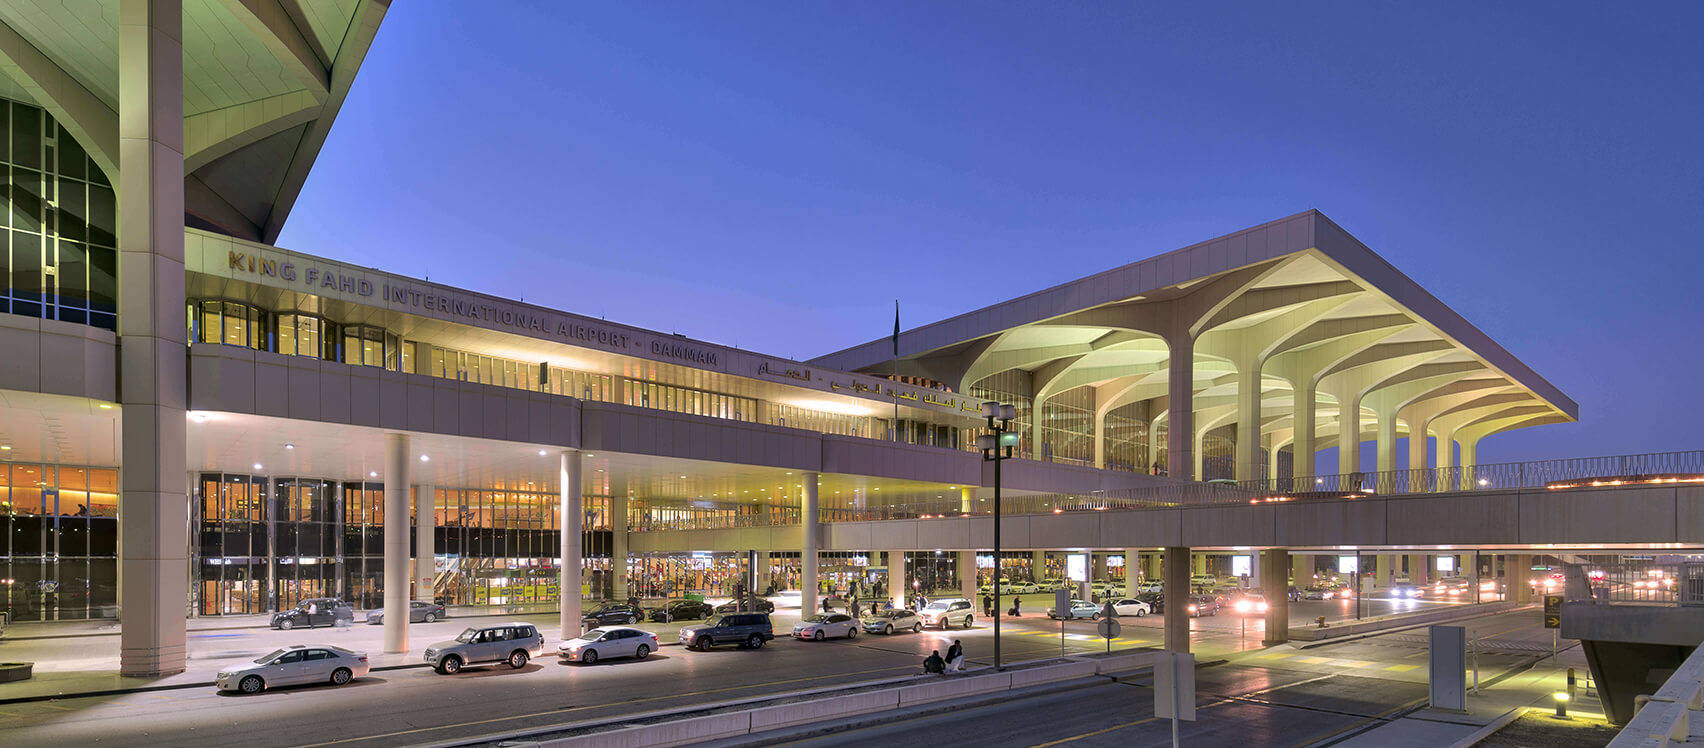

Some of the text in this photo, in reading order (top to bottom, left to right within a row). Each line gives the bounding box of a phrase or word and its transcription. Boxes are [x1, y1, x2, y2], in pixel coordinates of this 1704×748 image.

[228, 250, 296, 281] KING
[305, 268, 373, 297] FAHD
[383, 284, 551, 334] INTERNATIONAL
[557, 320, 629, 350] AIRPORT
[651, 340, 719, 366] DAMMAM
